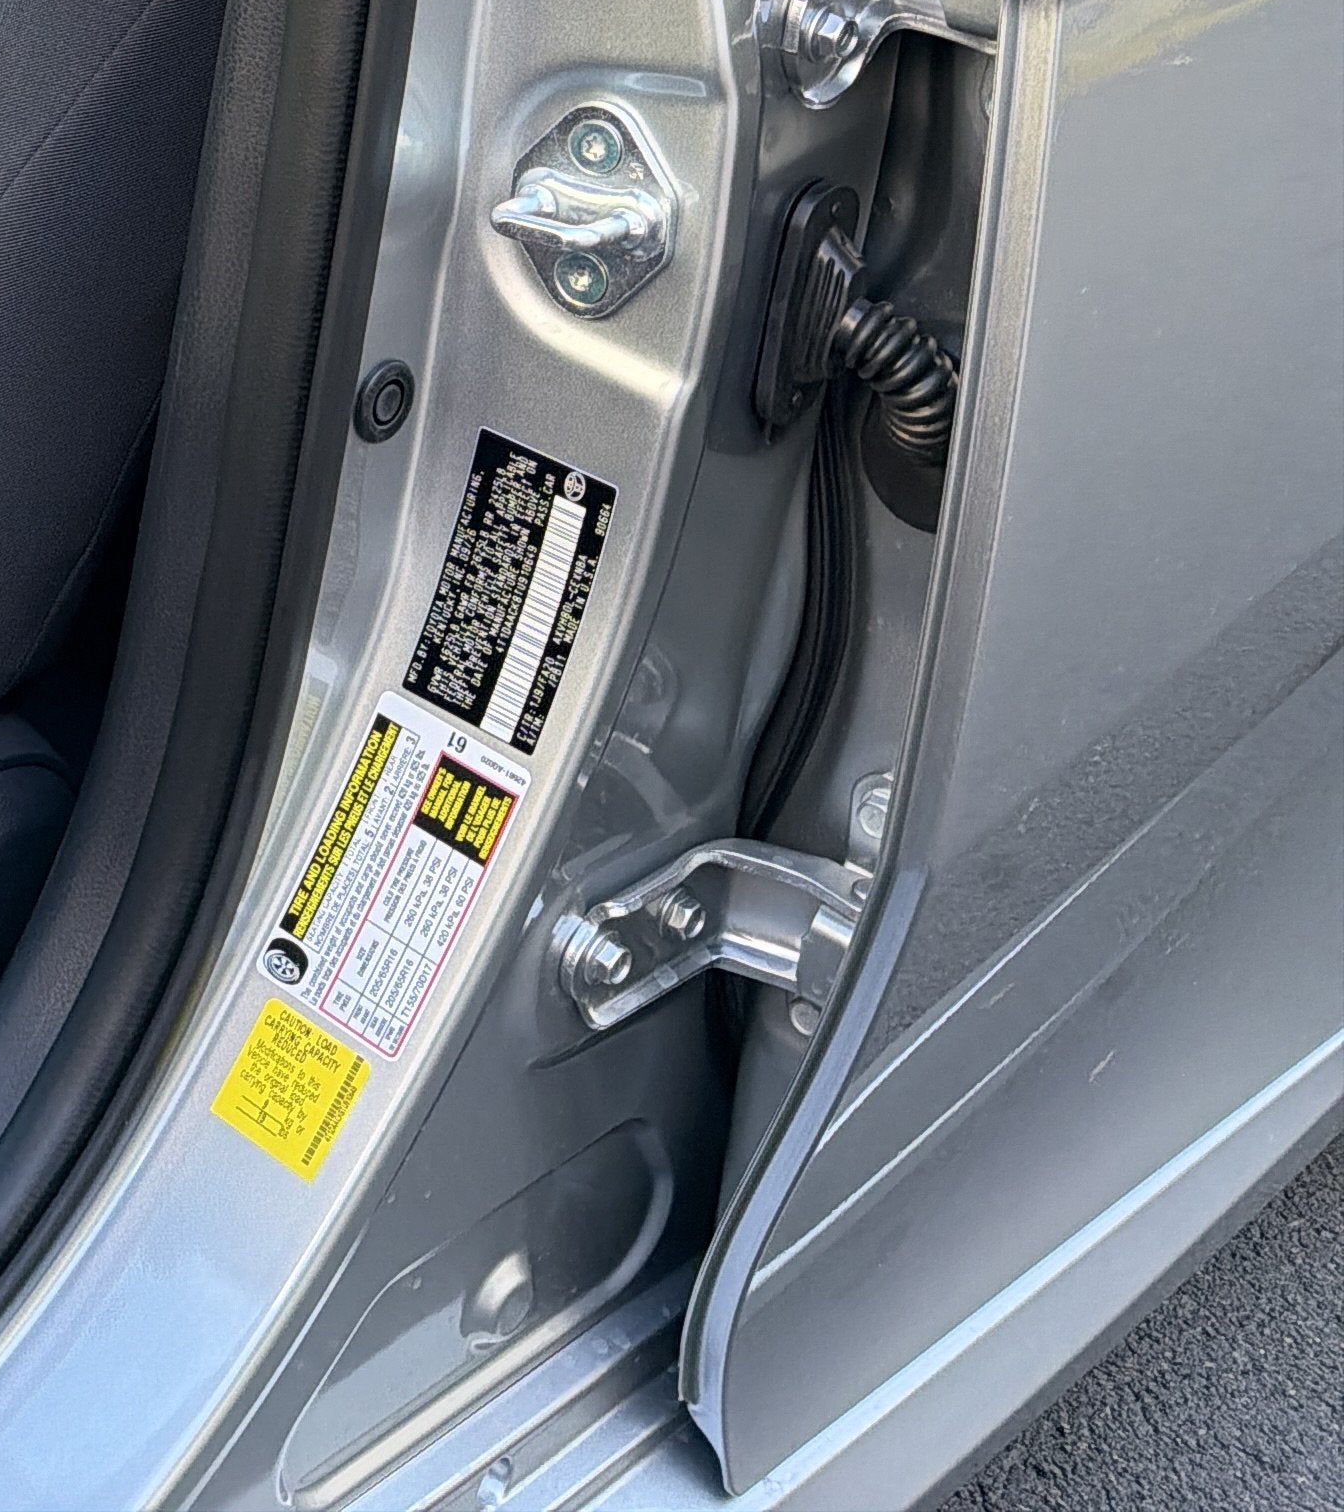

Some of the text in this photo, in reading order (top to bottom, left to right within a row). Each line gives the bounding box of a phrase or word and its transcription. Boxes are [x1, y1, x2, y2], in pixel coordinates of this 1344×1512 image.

[592, 501, 613, 538] 90664
[437, 559, 457, 596] MOTOR
[562, 615, 580, 645] MADE
[573, 594, 586, 610] IN
[426, 664, 445, 694] GVWR
[452, 589, 470, 620] GAWR
[462, 571, 476, 589] FR
[365, 720, 401, 782] CHARGEMENT
[446, 731, 468, 754] 61
[355, 788, 371, 805] ET
[361, 777, 376, 793] LE
[287, 728, 384, 918] TIRE AND LOADING INFORMATION
[342, 800, 365, 833] PNEUS
[313, 911, 335, 948] NOMBRE
[330, 899, 341, 913] DE
[362, 826, 375, 839] 5
[382, 784, 395, 796] 2
[404, 733, 417, 746] 3
[334, 828, 352, 849] LES
[326, 844, 344, 867] SUR
[427, 855, 443, 875] PSI
[421, 872, 434, 888] 38
[443, 864, 459, 885] PSI
[459, 874, 475, 895] PSI
[437, 882, 450, 898] 38
[453, 892, 467, 908] 60
[306, 908, 327, 942] SEATING
[321, 870, 344, 910] CAPACITY
[402, 906, 418, 928] 260
[418, 917, 434, 938] 260
[434, 927, 451, 948] 420
[367, 946, 399, 998] 205/65R16
[383, 957, 415, 1009] 205/65R16
[399, 961, 434, 1018] T155/70D17
[262, 1012, 341, 1075] CARRYING CAPACITY
[270, 1031, 308, 1065] REDUCED
[314, 1033, 339, 1057] LOAD
